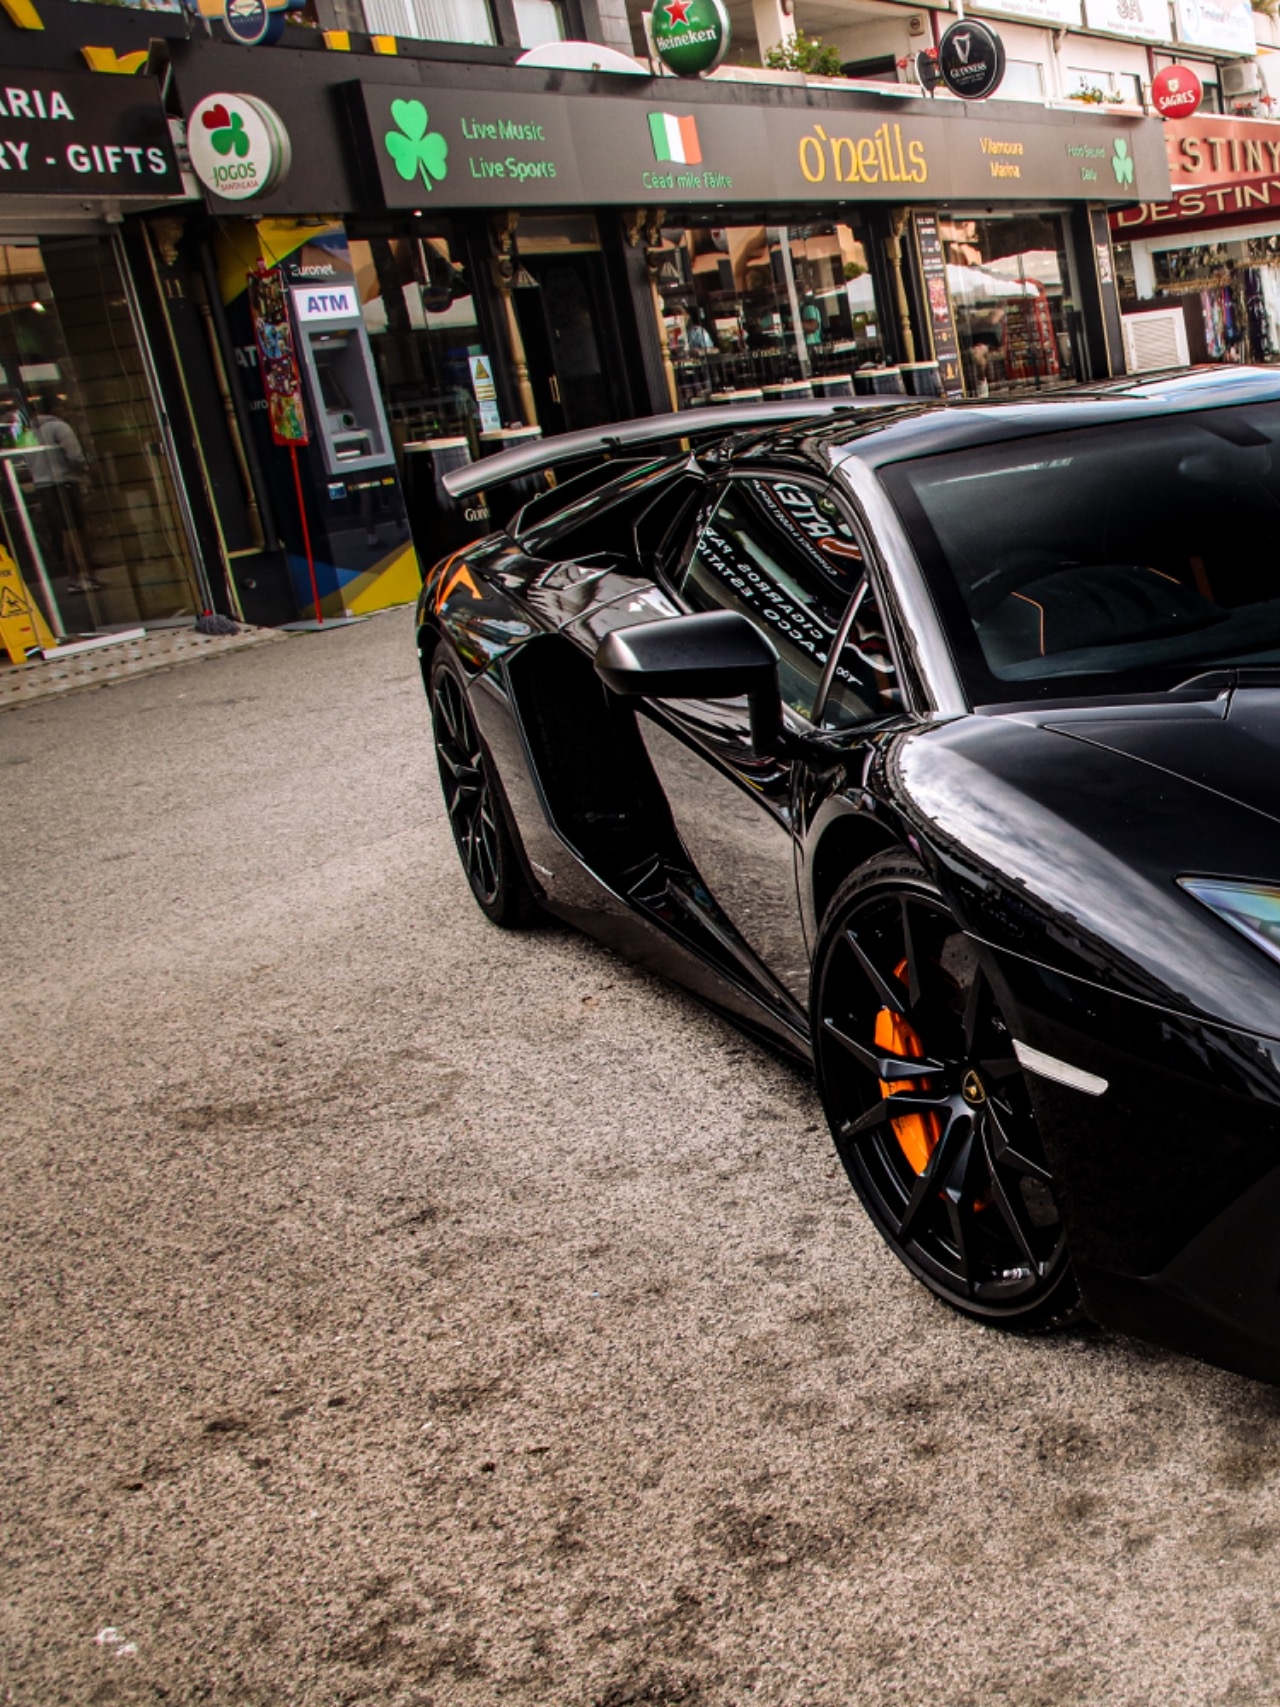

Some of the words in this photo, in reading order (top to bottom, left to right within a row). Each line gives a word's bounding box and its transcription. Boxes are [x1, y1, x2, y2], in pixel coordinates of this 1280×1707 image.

[656, 27, 717, 52] Heineken
[950, 61, 987, 79] GUINNESS
[1159, 91, 1196, 111] SAGRES
[461, 117, 497, 141] Live
[498, 119, 546, 141] Music
[66, 144, 168, 175] GIFTS
[469, 157, 505, 179] Live
[505, 157, 557, 184] Sports
[213, 161, 257, 188] JOGOS
[307, 294, 350, 313] ATM
[234, 345, 258, 368] AT
